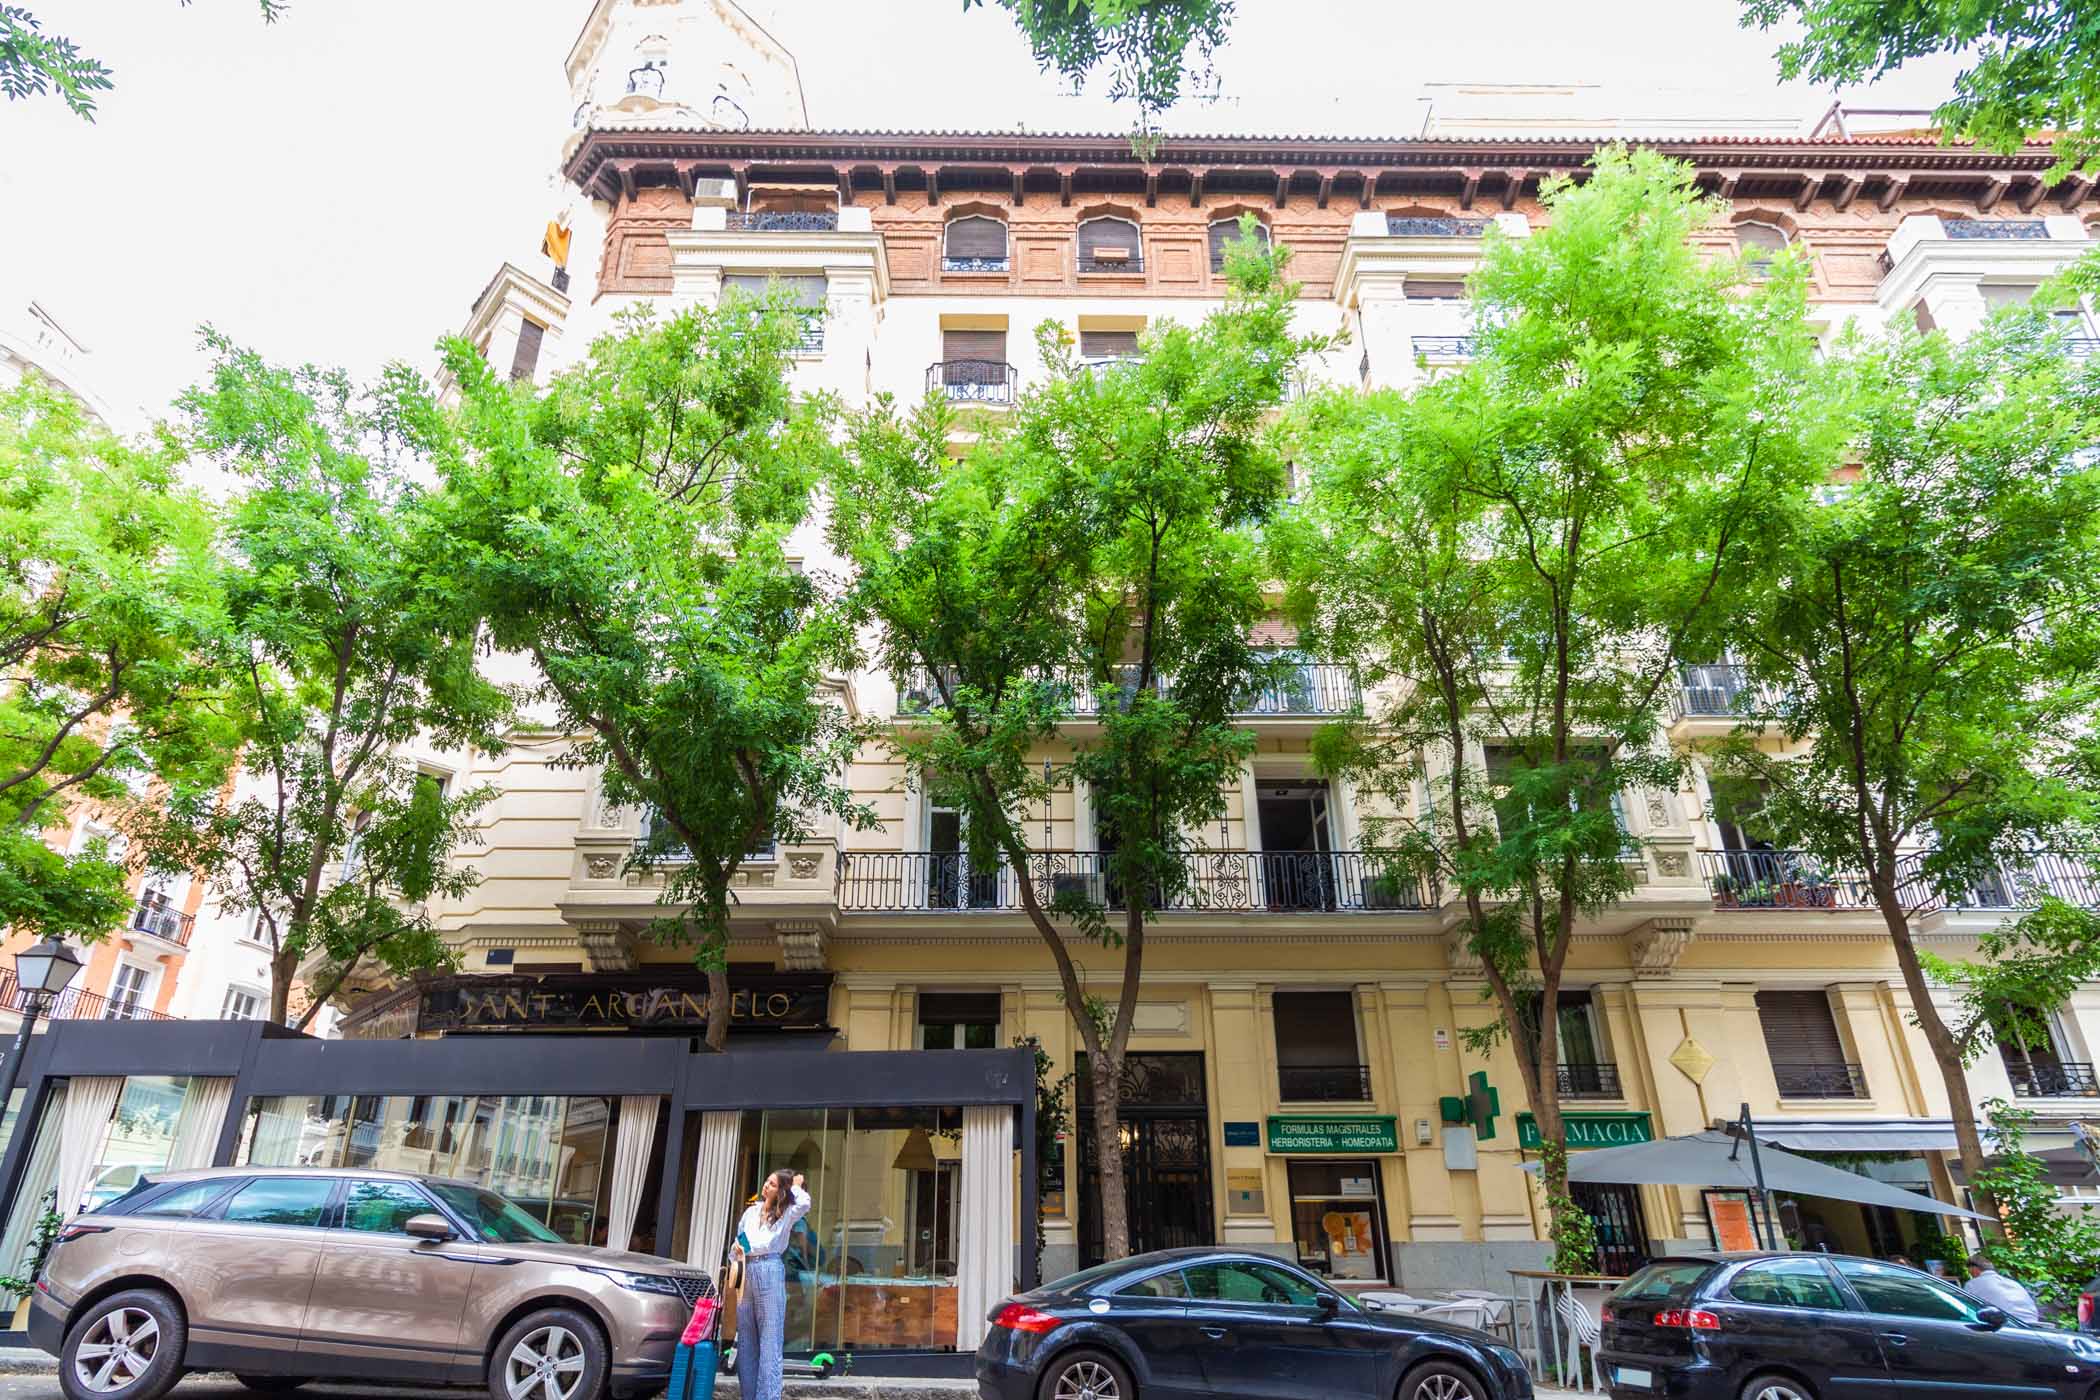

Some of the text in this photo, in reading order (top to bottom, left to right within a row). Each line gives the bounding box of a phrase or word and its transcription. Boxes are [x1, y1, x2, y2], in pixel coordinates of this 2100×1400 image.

[577, 992, 790, 1019] ARCANELO
[1281, 1124, 1382, 1135] FORMULAS MAGISTRALES
[1525, 1122, 1646, 1142] FMACIA
[1271, 1137, 1394, 1148] HERBORISTERIA HOMEOPATIA
